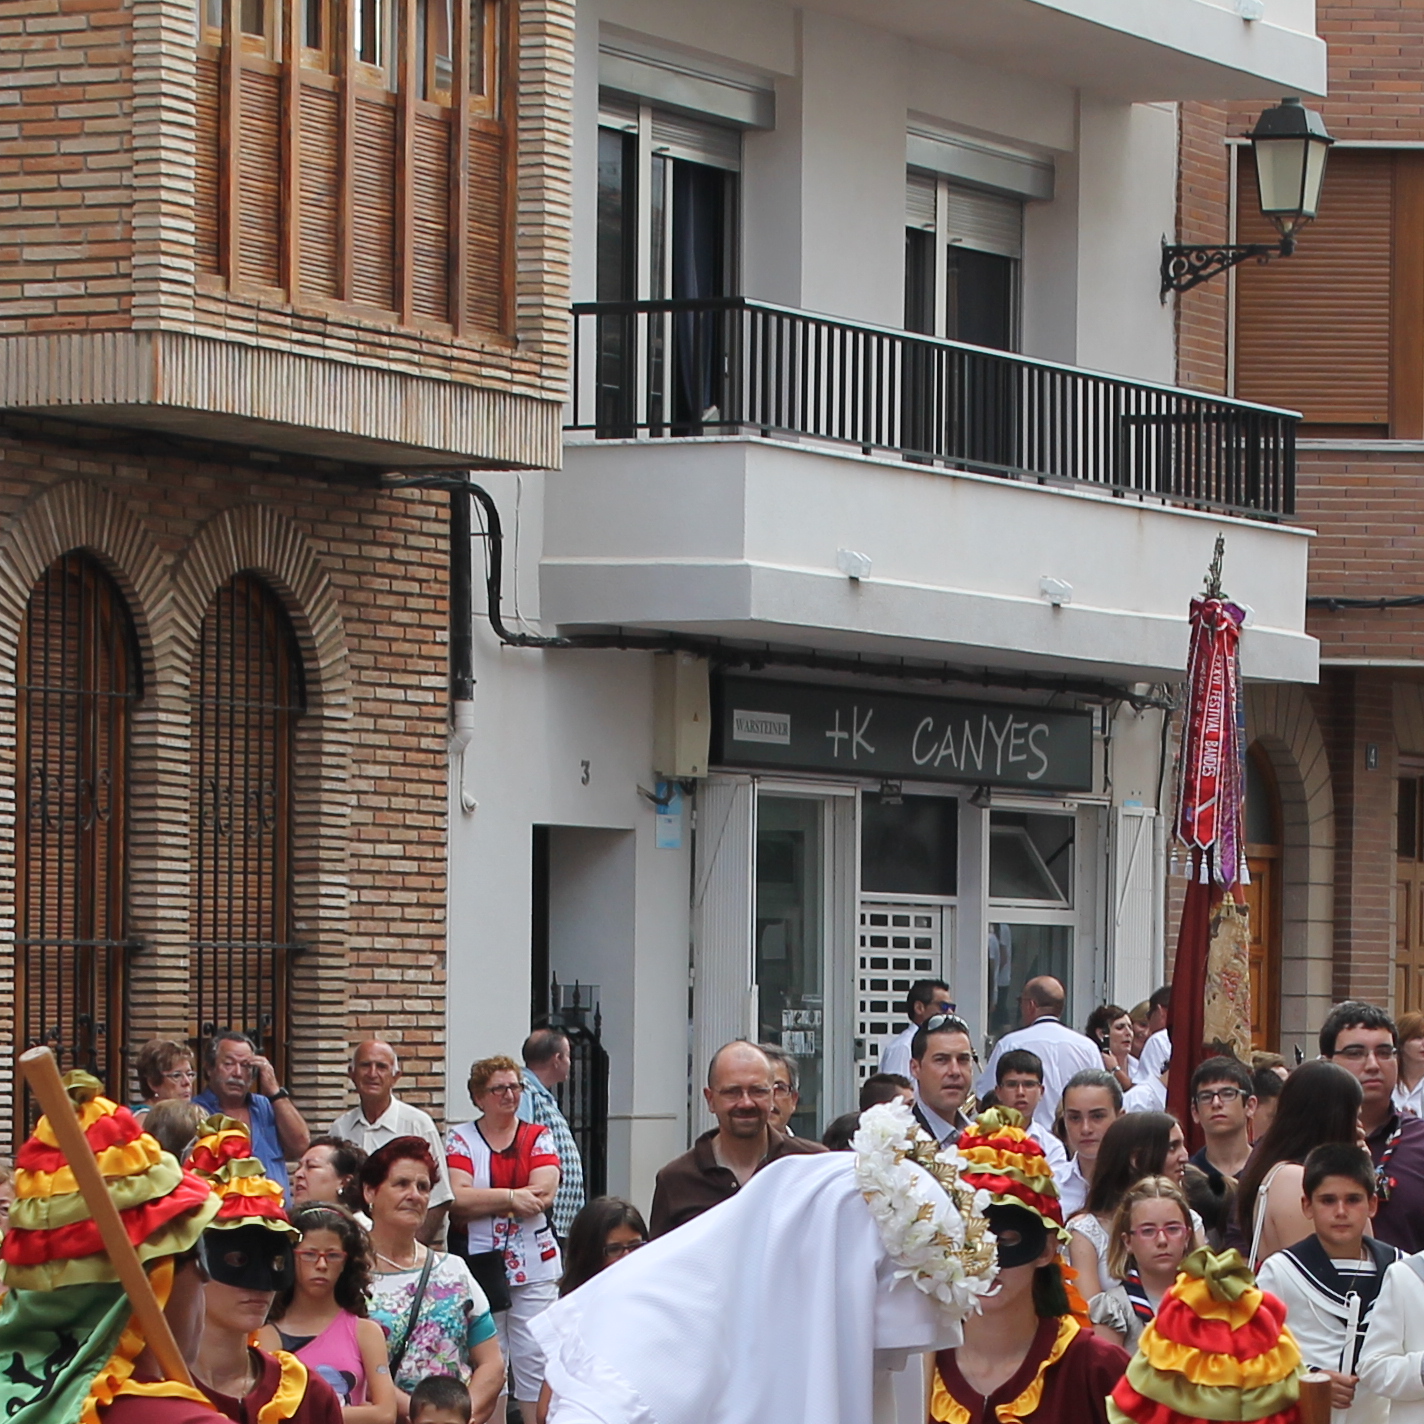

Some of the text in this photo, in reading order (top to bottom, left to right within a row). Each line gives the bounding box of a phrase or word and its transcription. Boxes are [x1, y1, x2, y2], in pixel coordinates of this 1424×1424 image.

[735, 717, 789, 736] WARSTEINER
[1206, 689, 1222, 734] FESTIVAL
[912, 714, 1049, 781] CANYES
[1202, 740, 1219, 777] BANDES
[1369, 748, 1376, 767] 4
[580, 759, 591, 786] 3
